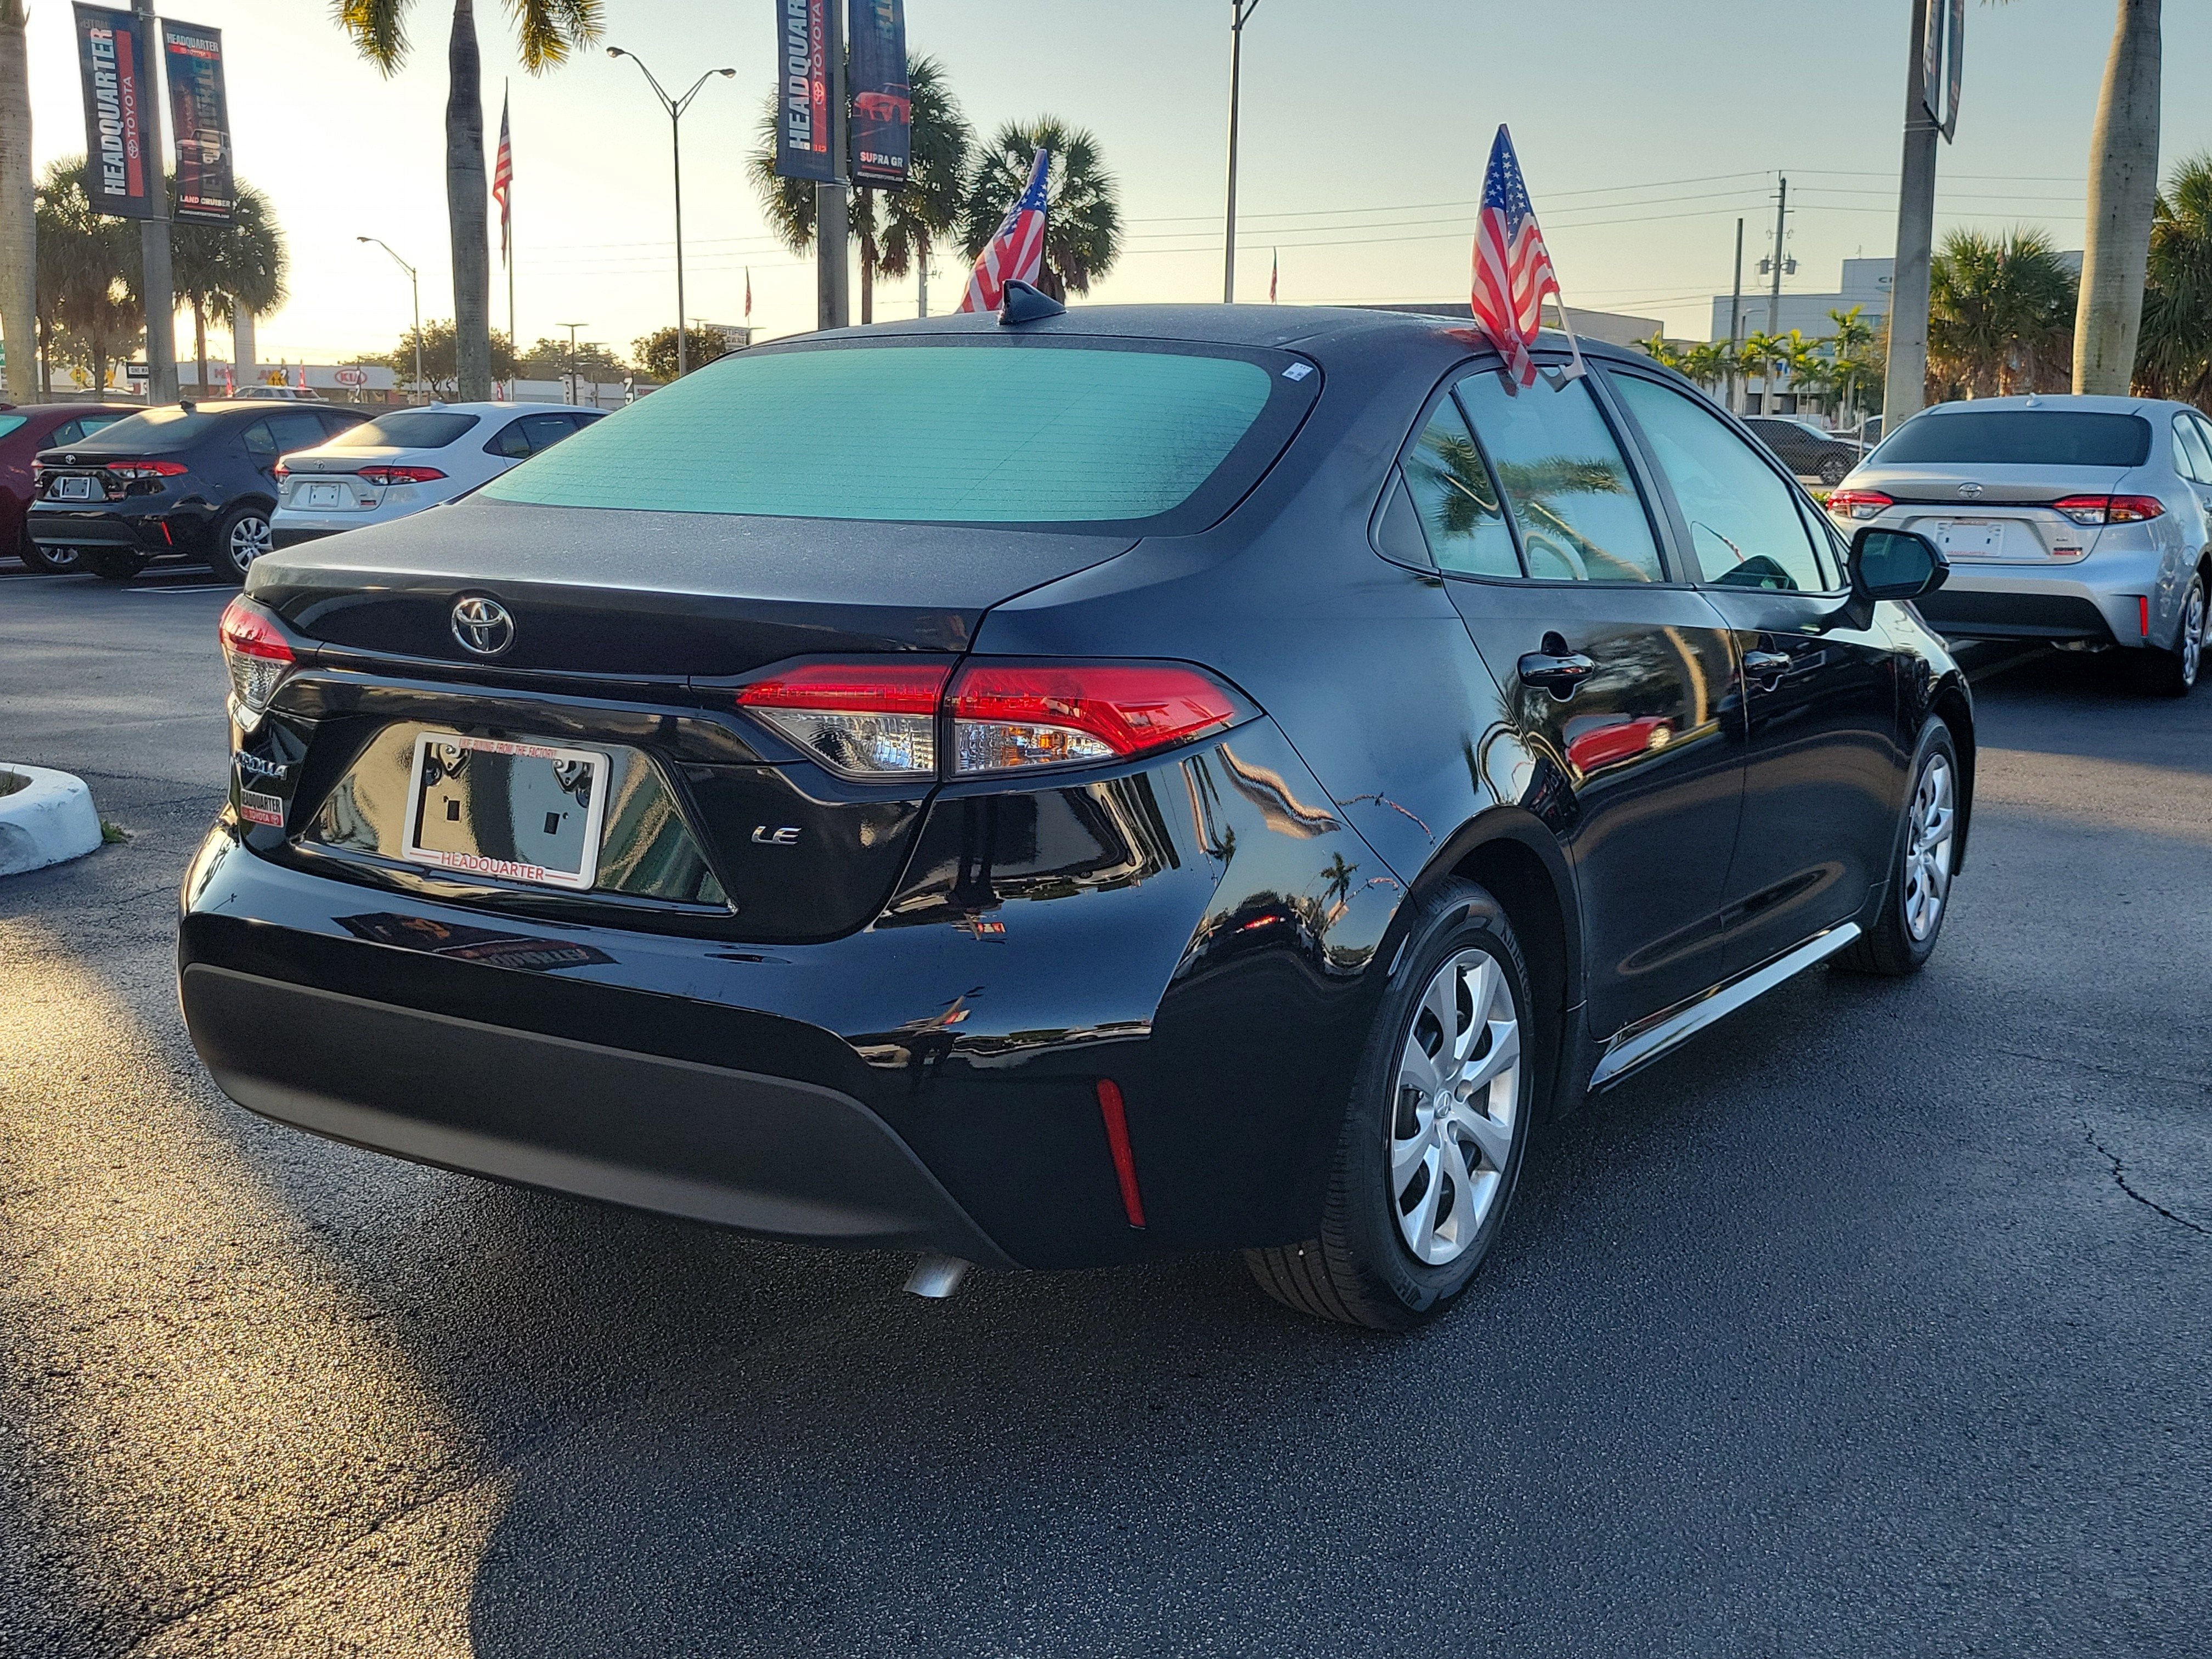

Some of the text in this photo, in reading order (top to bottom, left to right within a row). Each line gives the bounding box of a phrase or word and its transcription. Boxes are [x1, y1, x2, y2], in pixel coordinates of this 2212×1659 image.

[167, 32, 219, 52] HEADQUARTER
[812, 3, 822, 78] TOYOTA
[91, 27, 127, 196] HEADQUARTER
[123, 76, 137, 138] TOYOTA
[860, 151, 903, 168] SUPRA GR
[179, 195, 231, 207] LAND CRUISER
[496, 742, 513, 754] FROM
[515, 745, 526, 755] THE
[249, 809, 270, 823] TOYOTA
[751, 826, 802, 845] LE
[441, 851, 544, 881] HEADQUARTER
